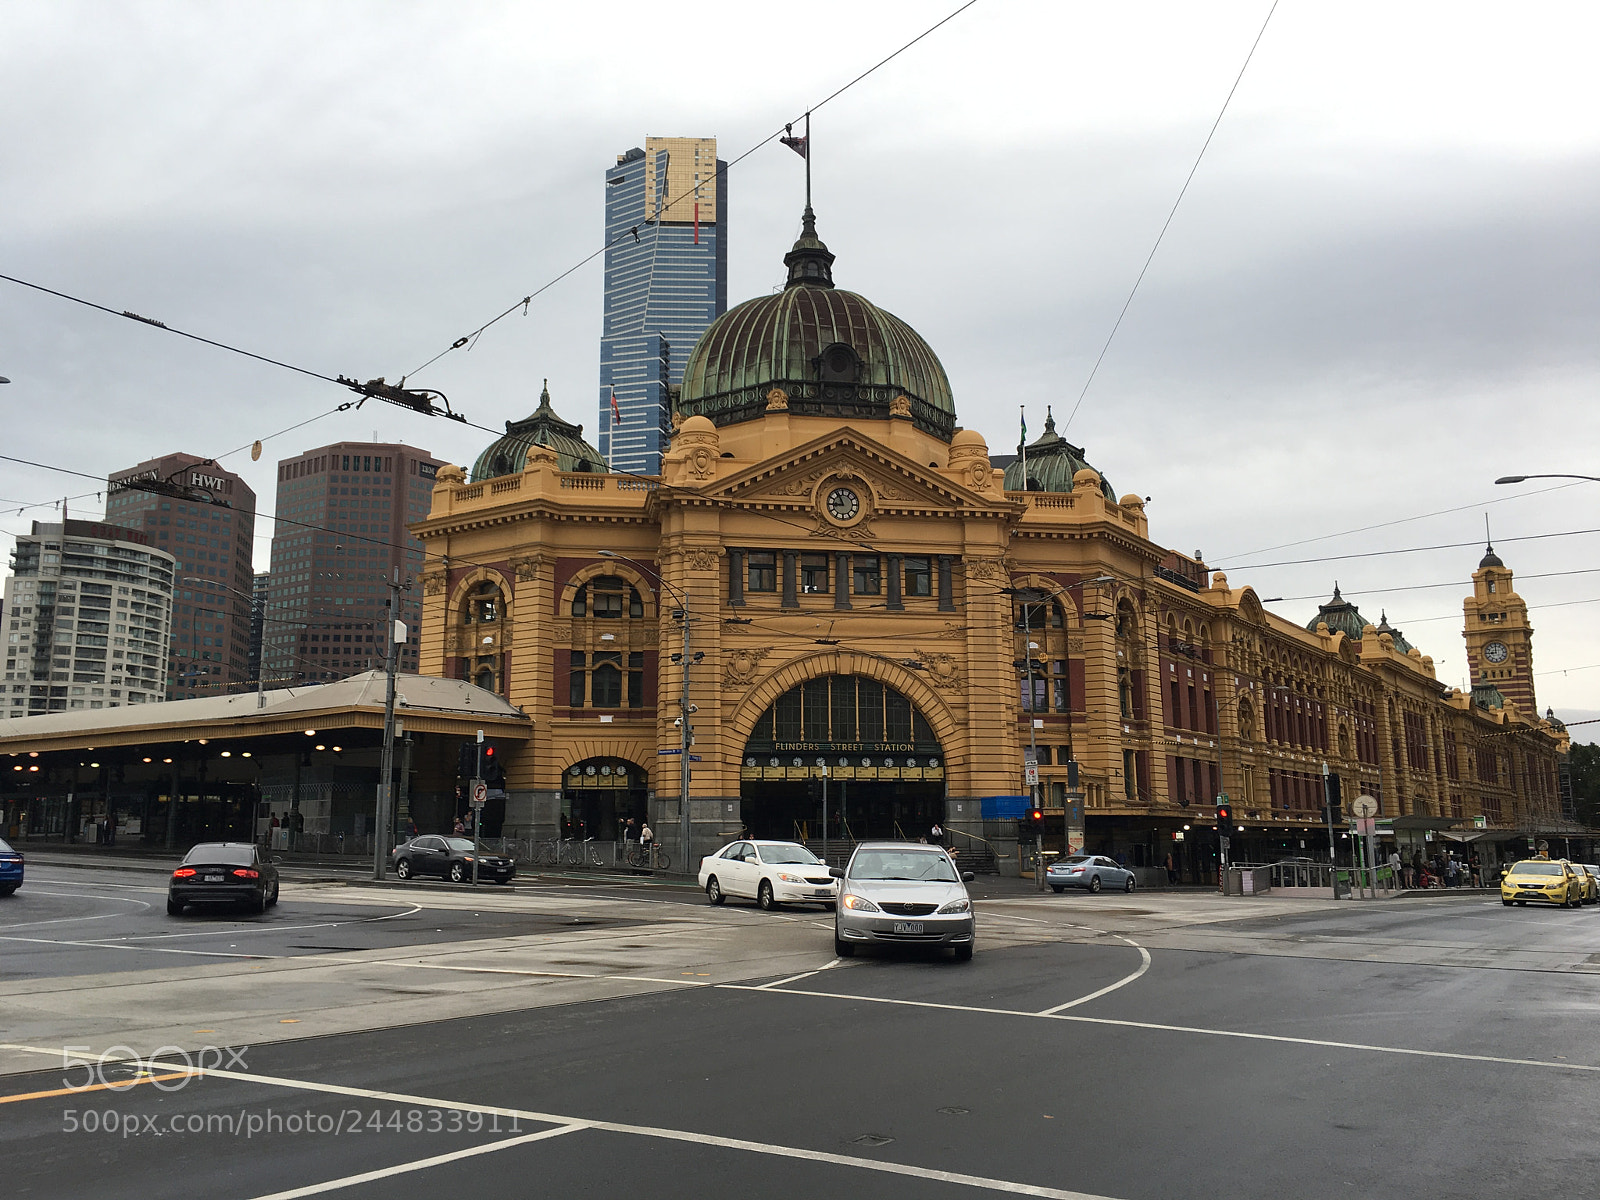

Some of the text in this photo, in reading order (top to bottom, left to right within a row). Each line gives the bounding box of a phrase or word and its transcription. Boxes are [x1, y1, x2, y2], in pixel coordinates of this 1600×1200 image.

[191, 472, 225, 491] HWT
[775, 742, 915, 752] FLINDERS STREET STATION
